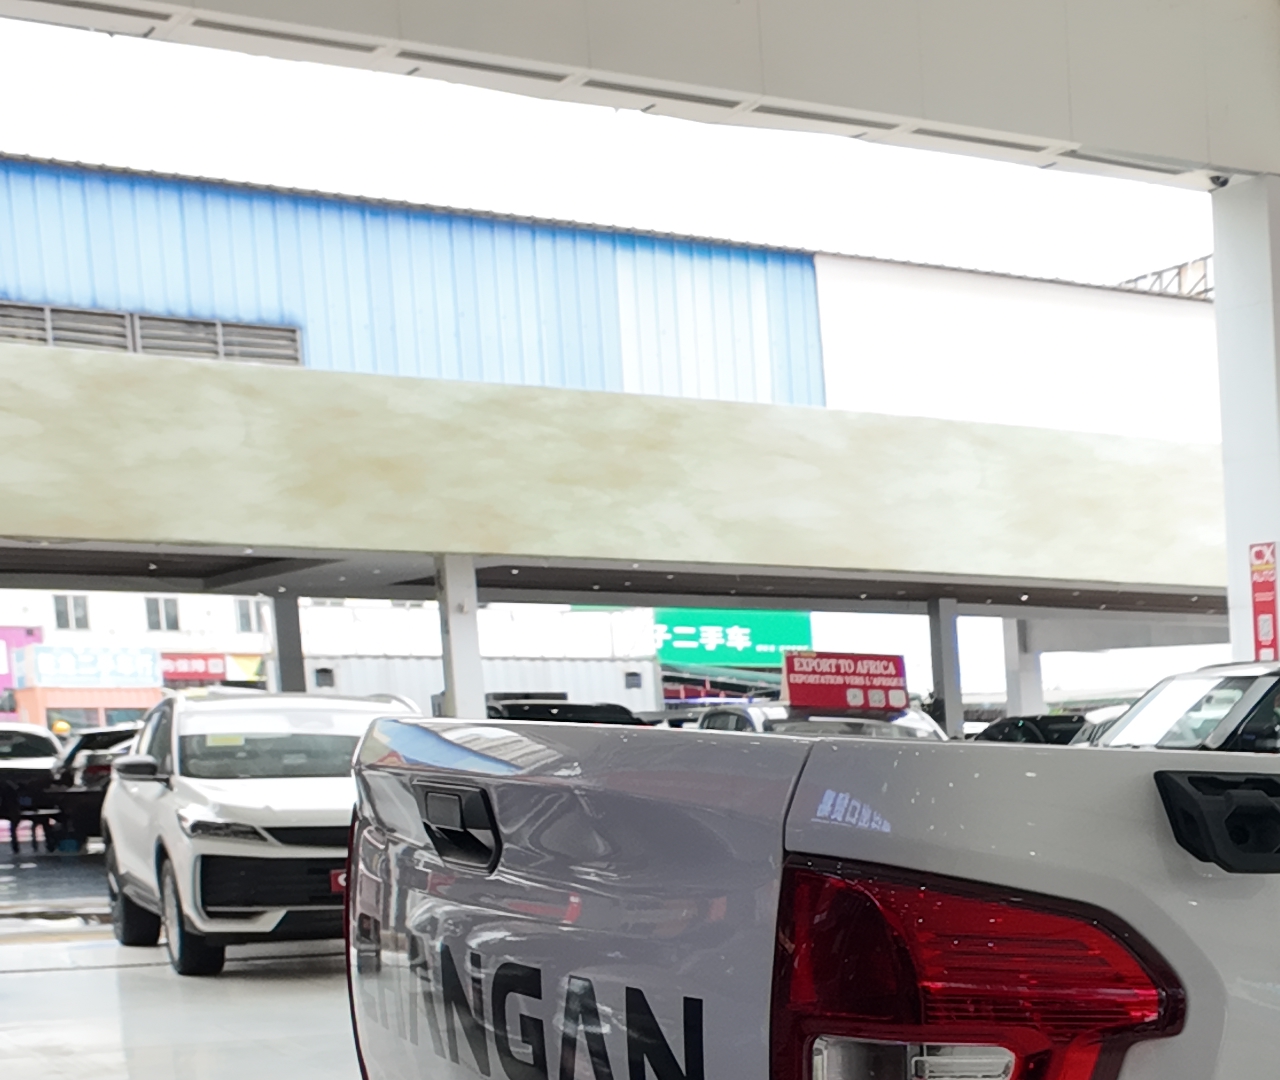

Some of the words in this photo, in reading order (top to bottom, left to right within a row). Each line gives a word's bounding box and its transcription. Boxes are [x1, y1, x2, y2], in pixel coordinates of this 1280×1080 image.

[1250, 545, 1275, 565] CX
[1252, 570, 1276, 583] AUTO
[793, 658, 837, 673] EXPORT
[838, 659, 854, 674] TO
[856, 660, 896, 675] AFRICA
